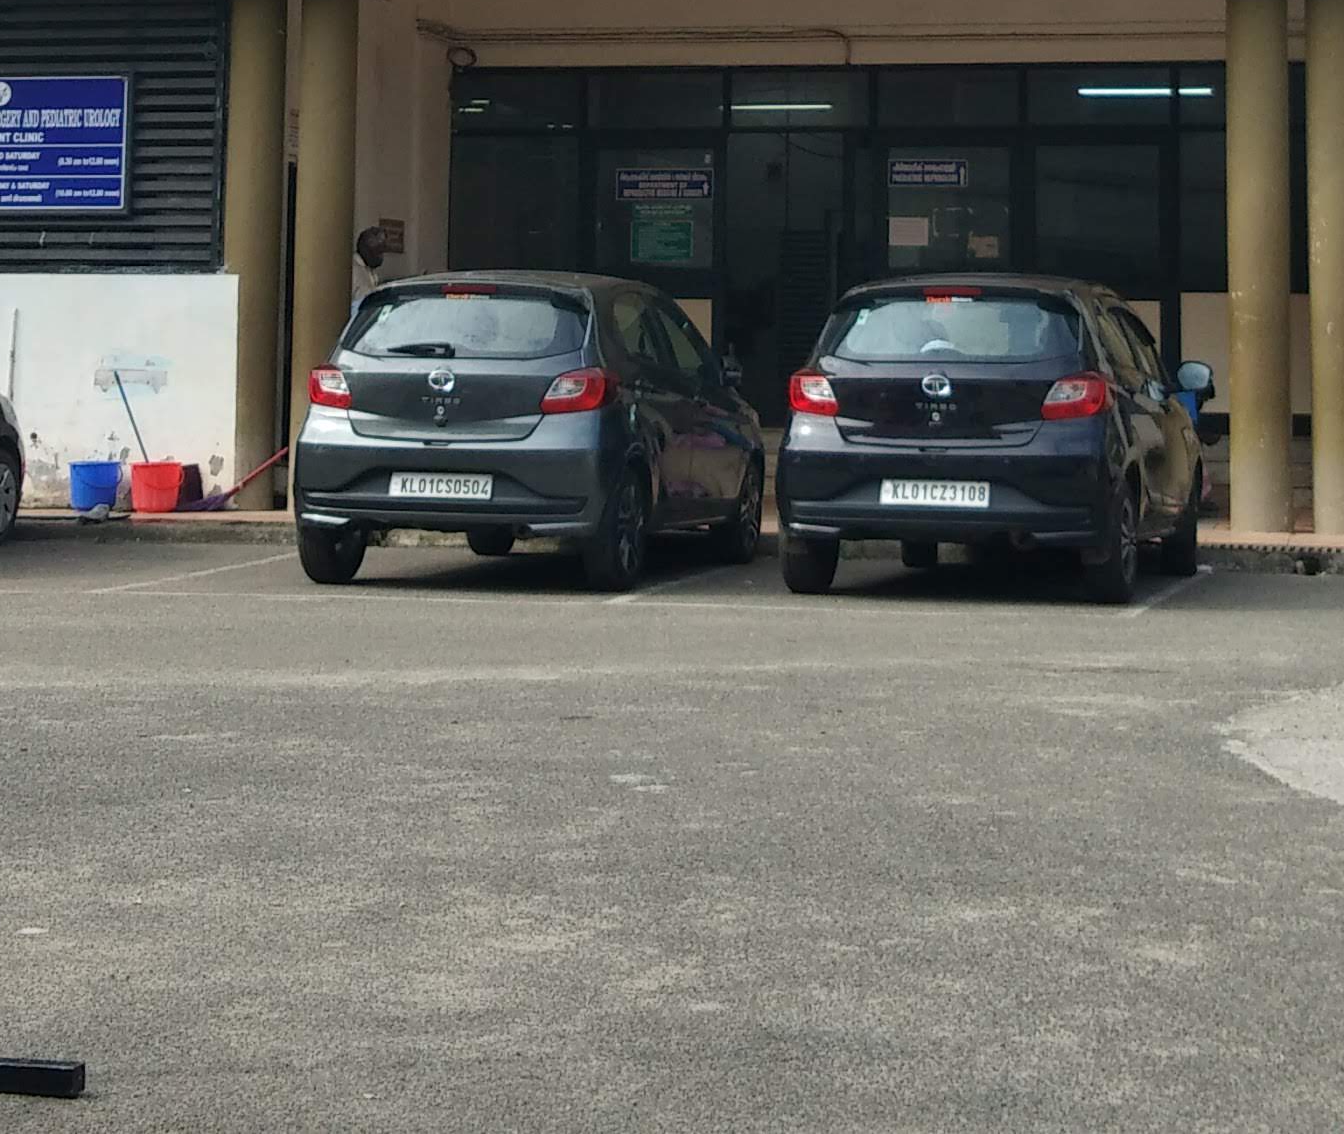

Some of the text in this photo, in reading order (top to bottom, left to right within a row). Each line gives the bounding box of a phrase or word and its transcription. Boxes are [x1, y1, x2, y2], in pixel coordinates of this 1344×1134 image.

[22, 109, 40, 128] AND
[40, 109, 83, 128] PEDIATRIC
[83, 109, 121, 127] UROLOGY
[13, 131, 45, 143] CLINIC
[399, 477, 490, 496] KL01CS0504
[891, 483, 987, 502] KL01CZ3108
